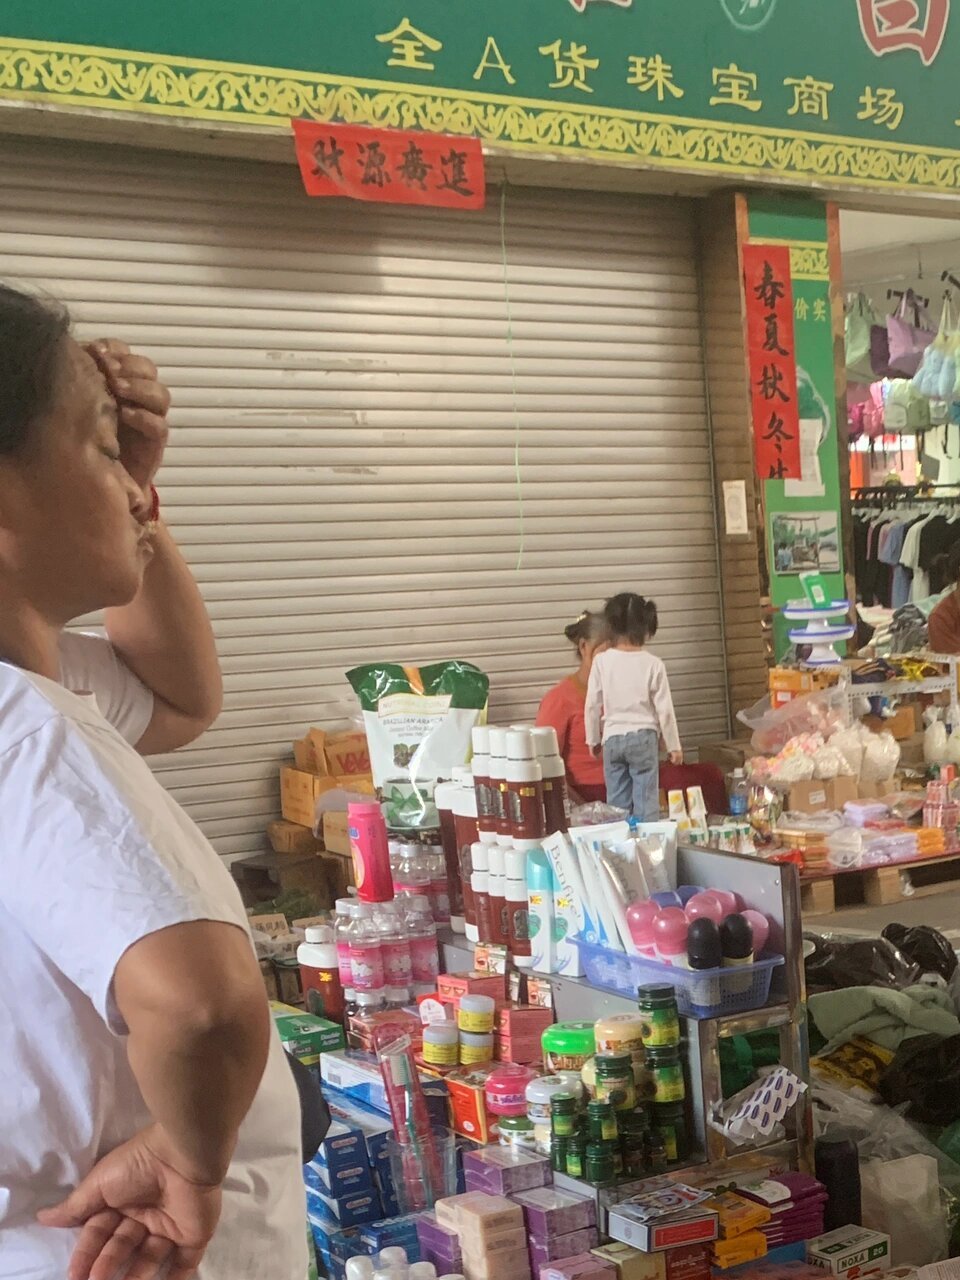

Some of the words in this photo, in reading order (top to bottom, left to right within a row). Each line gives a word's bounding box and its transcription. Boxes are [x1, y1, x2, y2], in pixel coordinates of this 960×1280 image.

[375, 18, 906, 132] 全A货珠宝商场
[841, 1253, 865, 1269] NOXA
